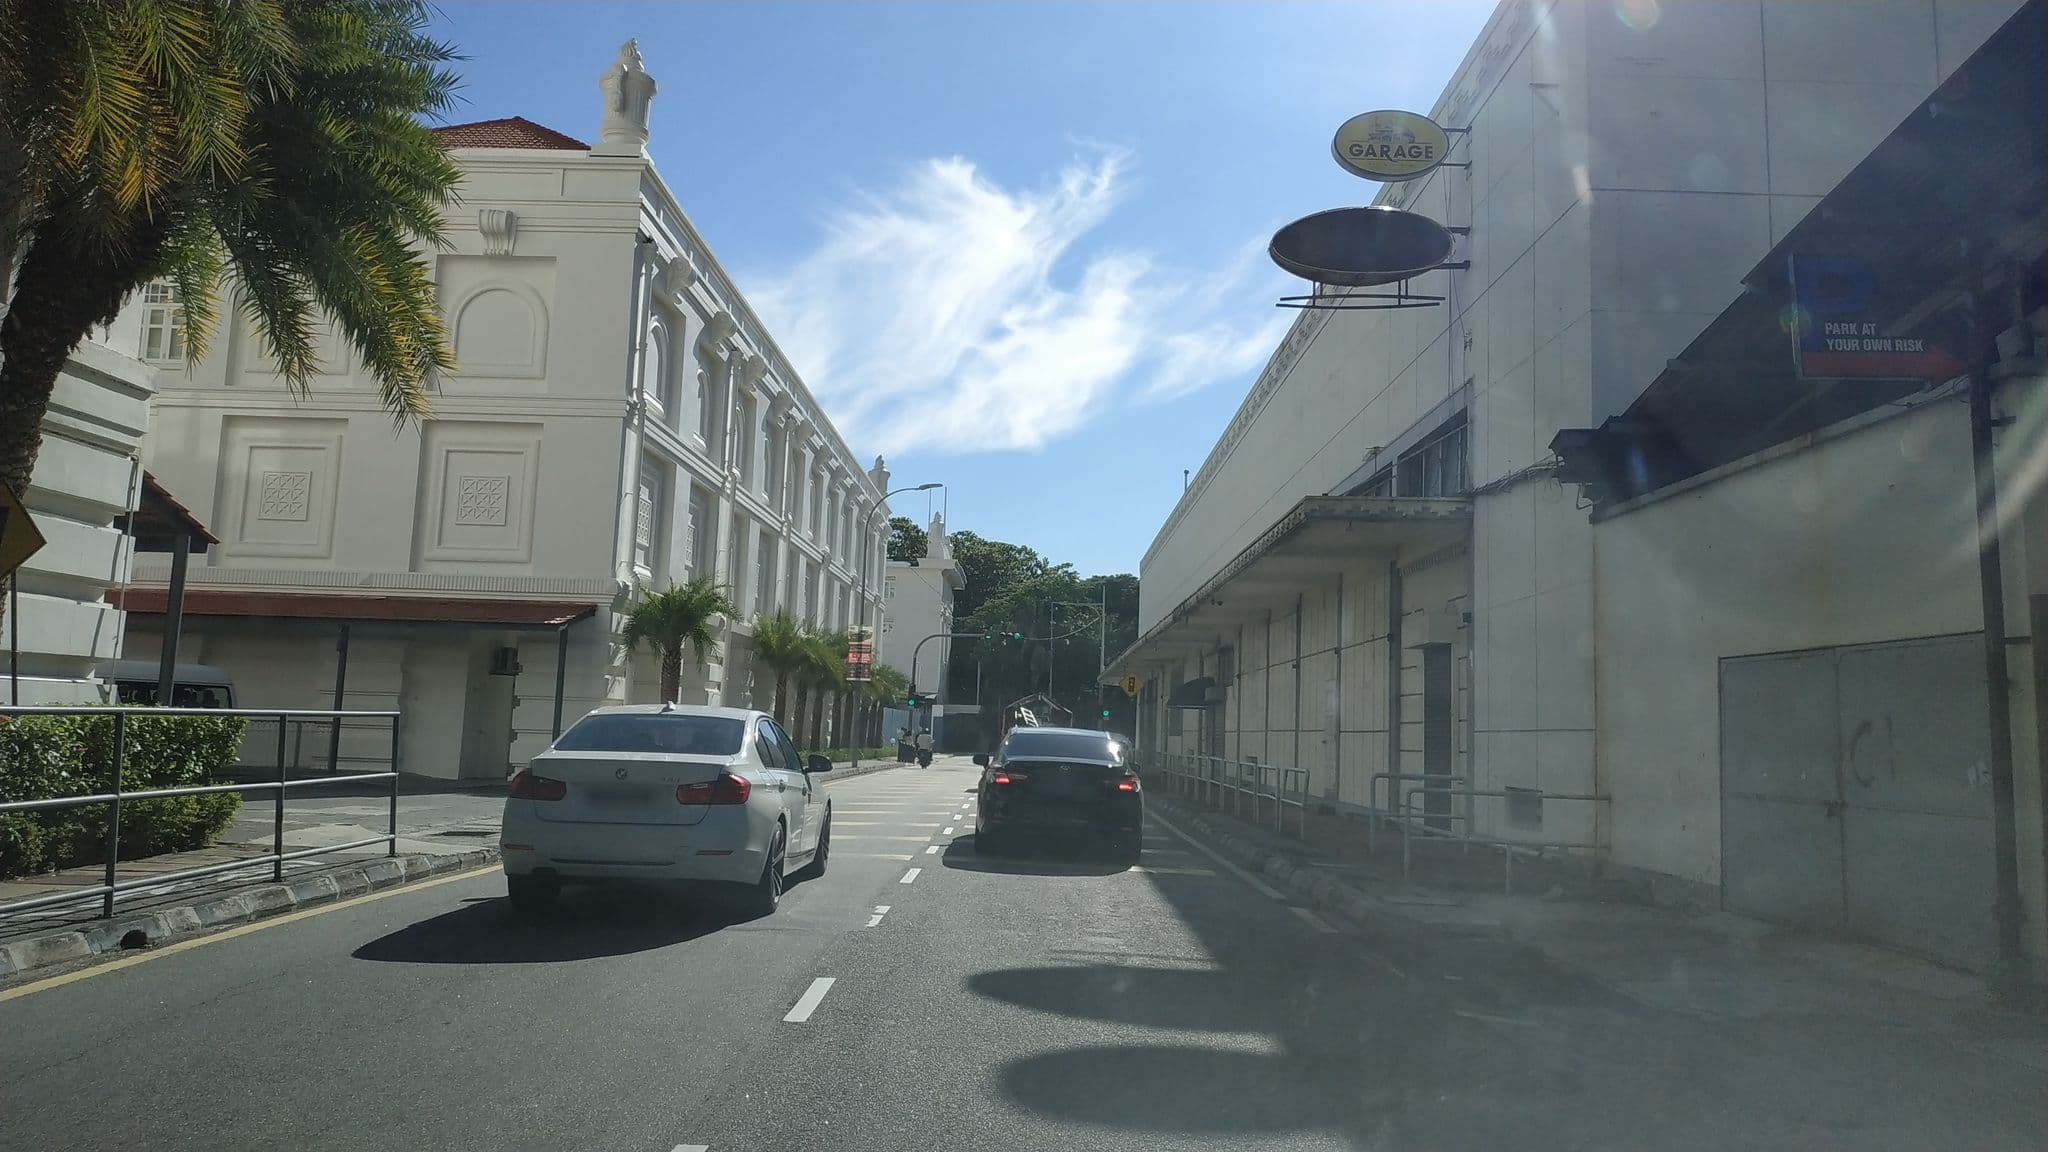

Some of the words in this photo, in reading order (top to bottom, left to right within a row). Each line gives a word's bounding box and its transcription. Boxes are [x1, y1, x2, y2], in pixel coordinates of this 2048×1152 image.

[1349, 143, 1434, 161] GARAGE
[1825, 322, 1858, 335] PARK
[1862, 322, 1876, 335] AT
[1826, 338, 1860, 351] YOUR
[1863, 338, 1892, 351] OWN
[1895, 338, 1924, 351] RISK
